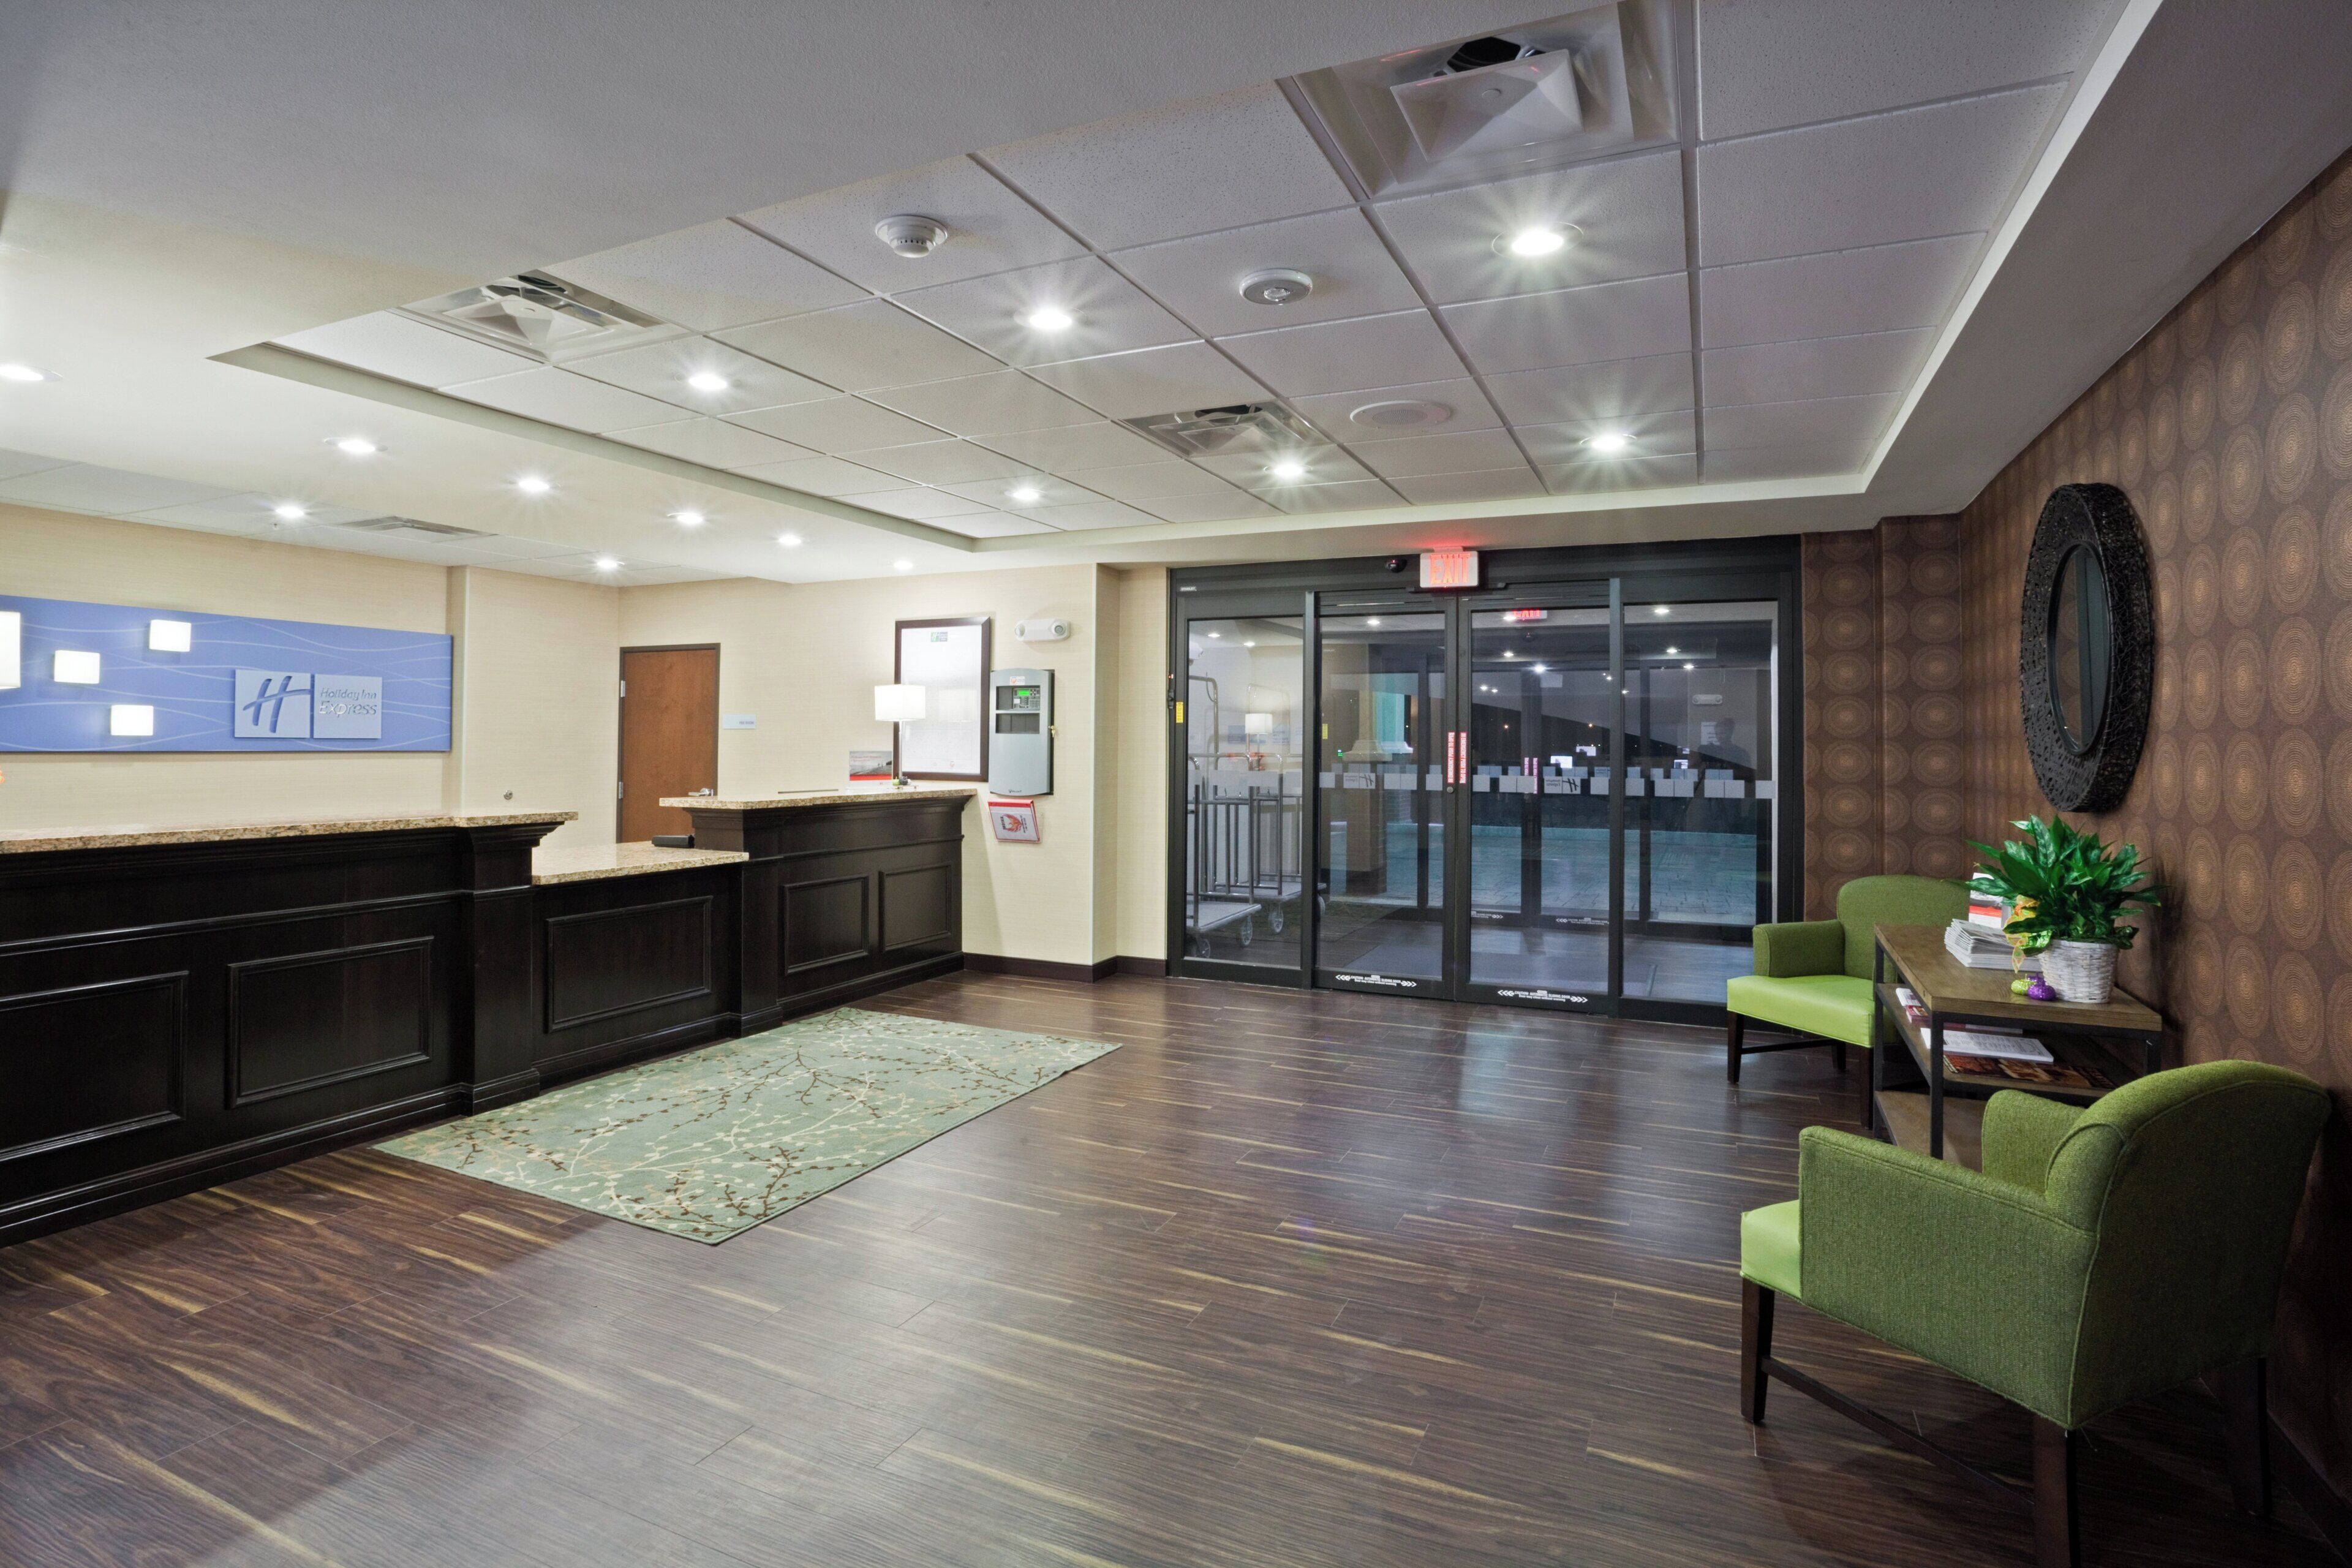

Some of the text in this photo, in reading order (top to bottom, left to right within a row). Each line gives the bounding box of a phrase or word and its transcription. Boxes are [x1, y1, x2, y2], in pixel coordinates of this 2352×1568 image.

[1430, 554, 1470, 584] EXIT
[320, 687, 377, 701] Holiday Inn
[318, 700, 377, 718] Express
